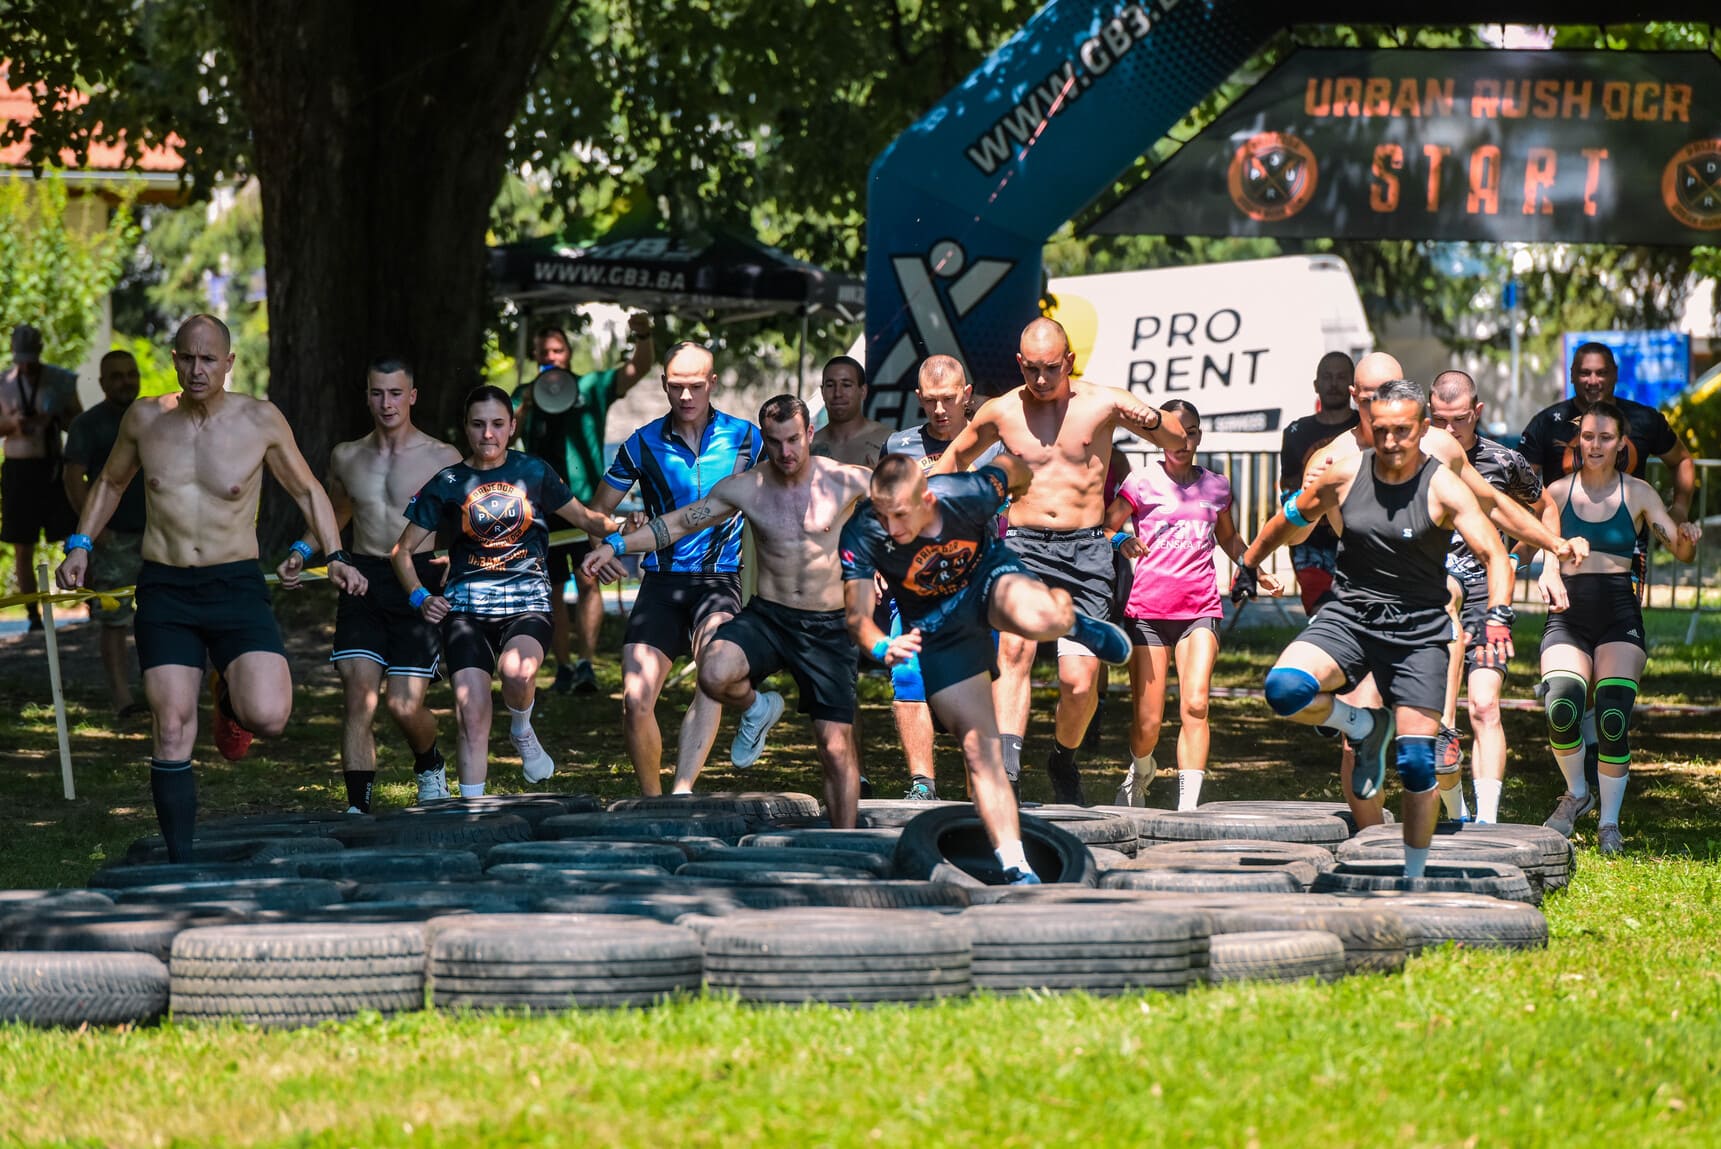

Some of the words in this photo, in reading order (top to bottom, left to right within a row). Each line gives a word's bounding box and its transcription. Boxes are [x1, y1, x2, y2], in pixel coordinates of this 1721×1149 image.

[1304, 77, 1455, 118] URBAN
[1471, 79, 1593, 119] RUSH
[1601, 81, 1693, 122] OCR
[1370, 143, 1609, 217] START
[534, 262, 685, 290] WWW.GB3.BA
[1131, 308, 1241, 350] PRO
[1127, 348, 1270, 394] RENT
[479, 513, 485, 521] P
[508, 509, 516, 517] U
